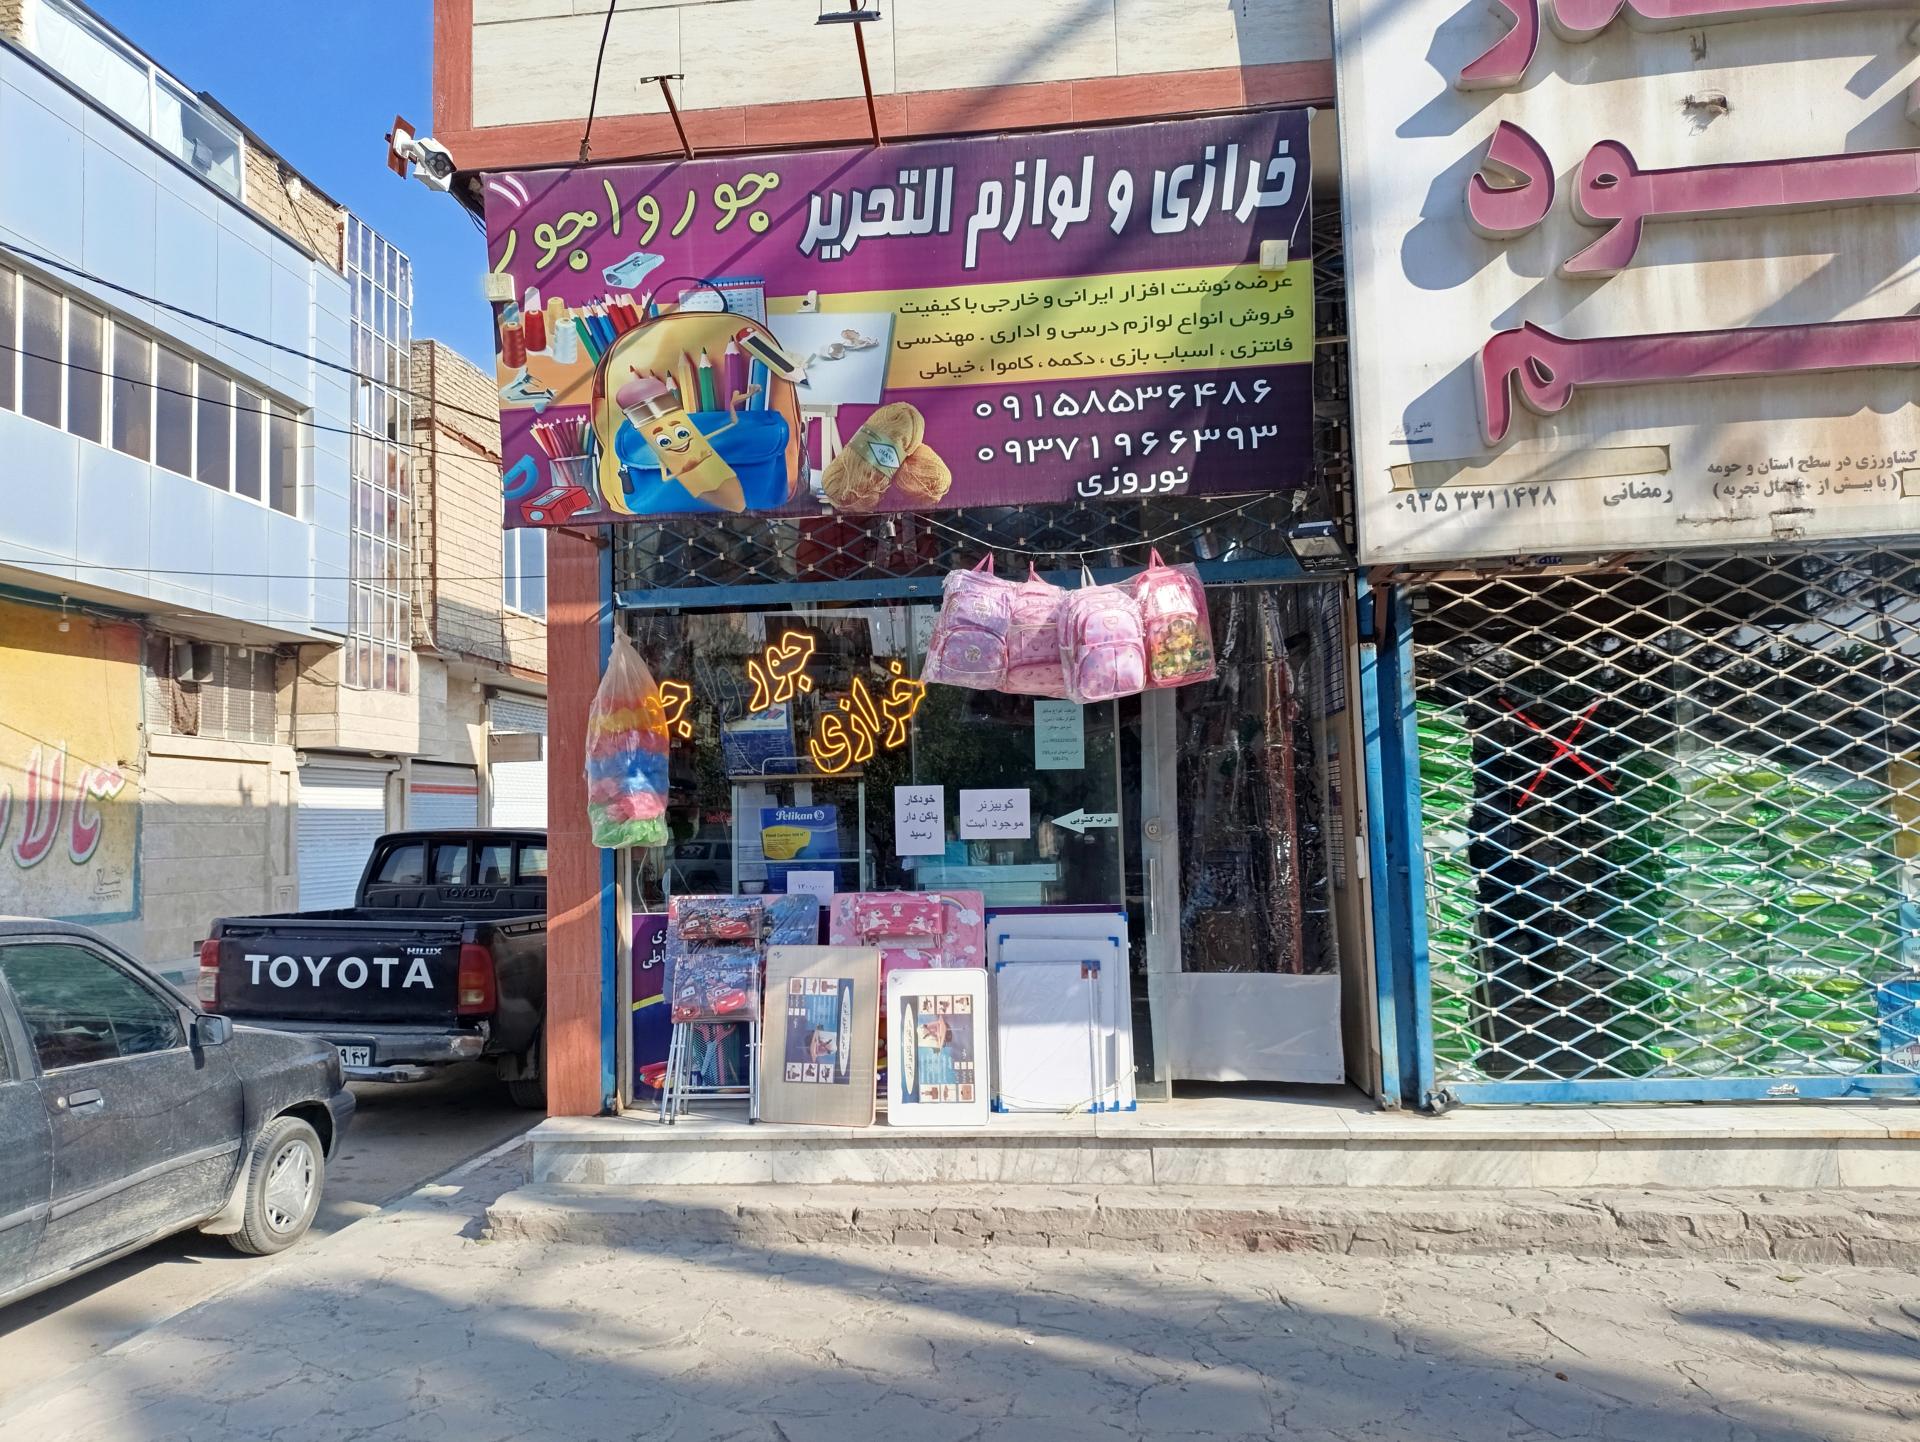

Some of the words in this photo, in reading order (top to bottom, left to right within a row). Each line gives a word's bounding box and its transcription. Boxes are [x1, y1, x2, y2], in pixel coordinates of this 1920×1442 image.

[1150, 139, 1296, 234] خرازی
[1107, 169, 1133, 234] و
[799, 165, 954, 261] التحریر
[964, 155, 1095, 269] لوازم
[1120, 282, 1165, 302] افزار
[1170, 279, 1231, 297] نوشت
[1235, 275, 1292, 292] عرضه
[965, 297, 977, 314] با
[981, 291, 1039, 313] خارجی
[1043, 295, 1053, 309] و
[1057, 286, 1113, 307] ایرانی
[900, 297, 961, 318] کیفیت
[1230, 305, 1295, 327] فروش
[1060, 320, 1119, 339] درسی
[1123, 313, 1173, 335] لوازم
[1177, 311, 1223, 334] انواع
[896, 331, 975, 350] مهندسی
[990, 323, 1040, 344] اداری
[1046, 326, 1056, 340] و
[1047, 351, 1096, 366] دکمه
[1110, 348, 1150, 367] بازی
[1154, 343, 1214, 364] اسباب
[919, 359, 976, 380] خیاطی
[990, 355, 1034, 375] کاموا
[1757, 456, 1794, 475] استان
[1798, 454, 1831, 472] سطح
[1835, 456, 1851, 471] در
[1855, 449, 1917, 470] کشاورزی
[1707, 463, 1742, 477] حومه
[1747, 465, 1754, 476] و
[1076, 465, 1189, 498] نوروزی
[1723, 480, 1760, 499] تجربه
[1817, 477, 1829, 495] از
[1603, 482, 1673, 508] رمضانی
[810, 660, 926, 774] خرازی
[904, 794, 936, 806] خودکار
[775, 810, 813, 821] Pelikan
[903, 812, 917, 823] دار
[920, 812, 939, 824] پاکن
[966, 817, 989, 829] است
[991, 818, 1024, 830] موجود
[909, 828, 932, 840] رسید
[443, 887, 493, 898] TOYOTA
[406, 947, 442, 956] HILUX
[244, 953, 434, 989] TOYOTA
